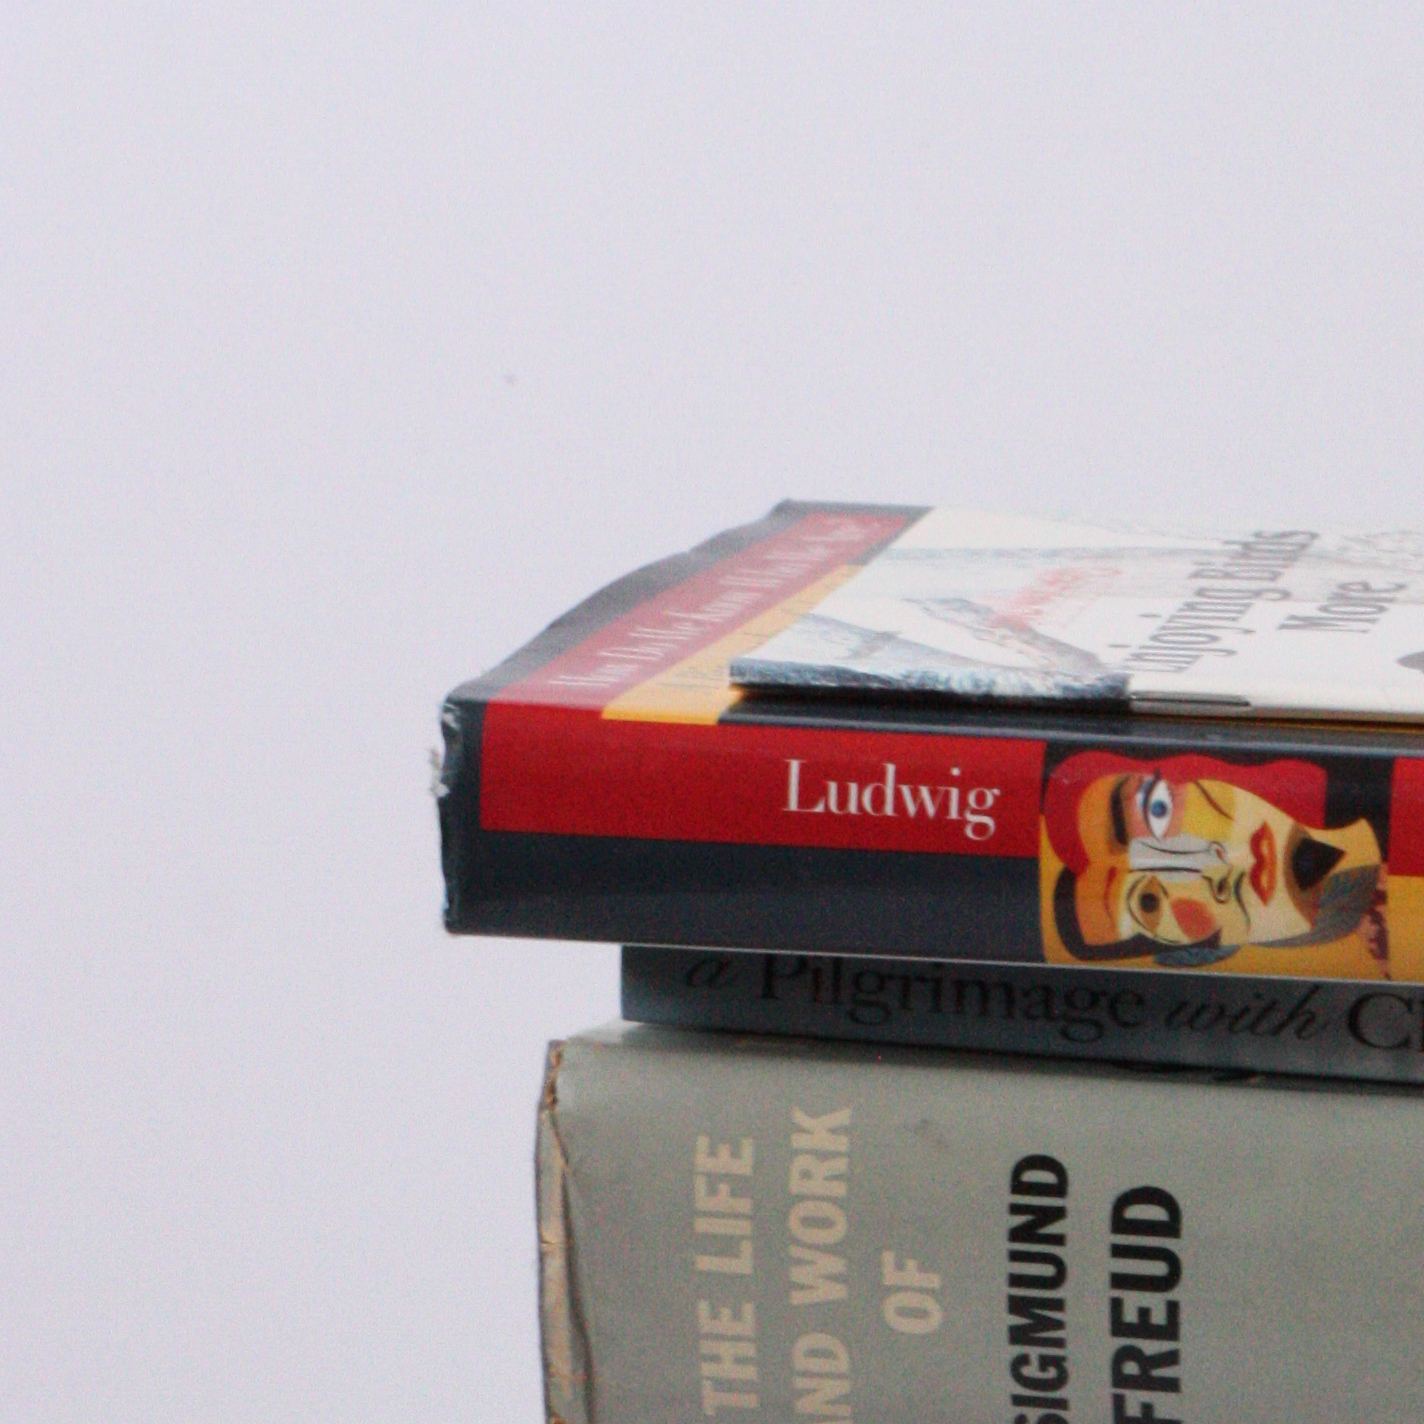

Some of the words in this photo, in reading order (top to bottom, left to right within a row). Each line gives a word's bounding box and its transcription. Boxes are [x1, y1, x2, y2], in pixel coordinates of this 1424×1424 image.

[1277, 580, 1407, 634] More
[782, 758, 1000, 841] Ludwig
[684, 956, 739, 991] a
[760, 953, 1147, 1044] Pilgrimage
[1161, 982, 1334, 1041] with
[693, 1133, 755, 1275] LIFE
[786, 1105, 853, 1305] WORK
[881, 1249, 945, 1336] OF
[700, 1297, 760, 1417] THE
